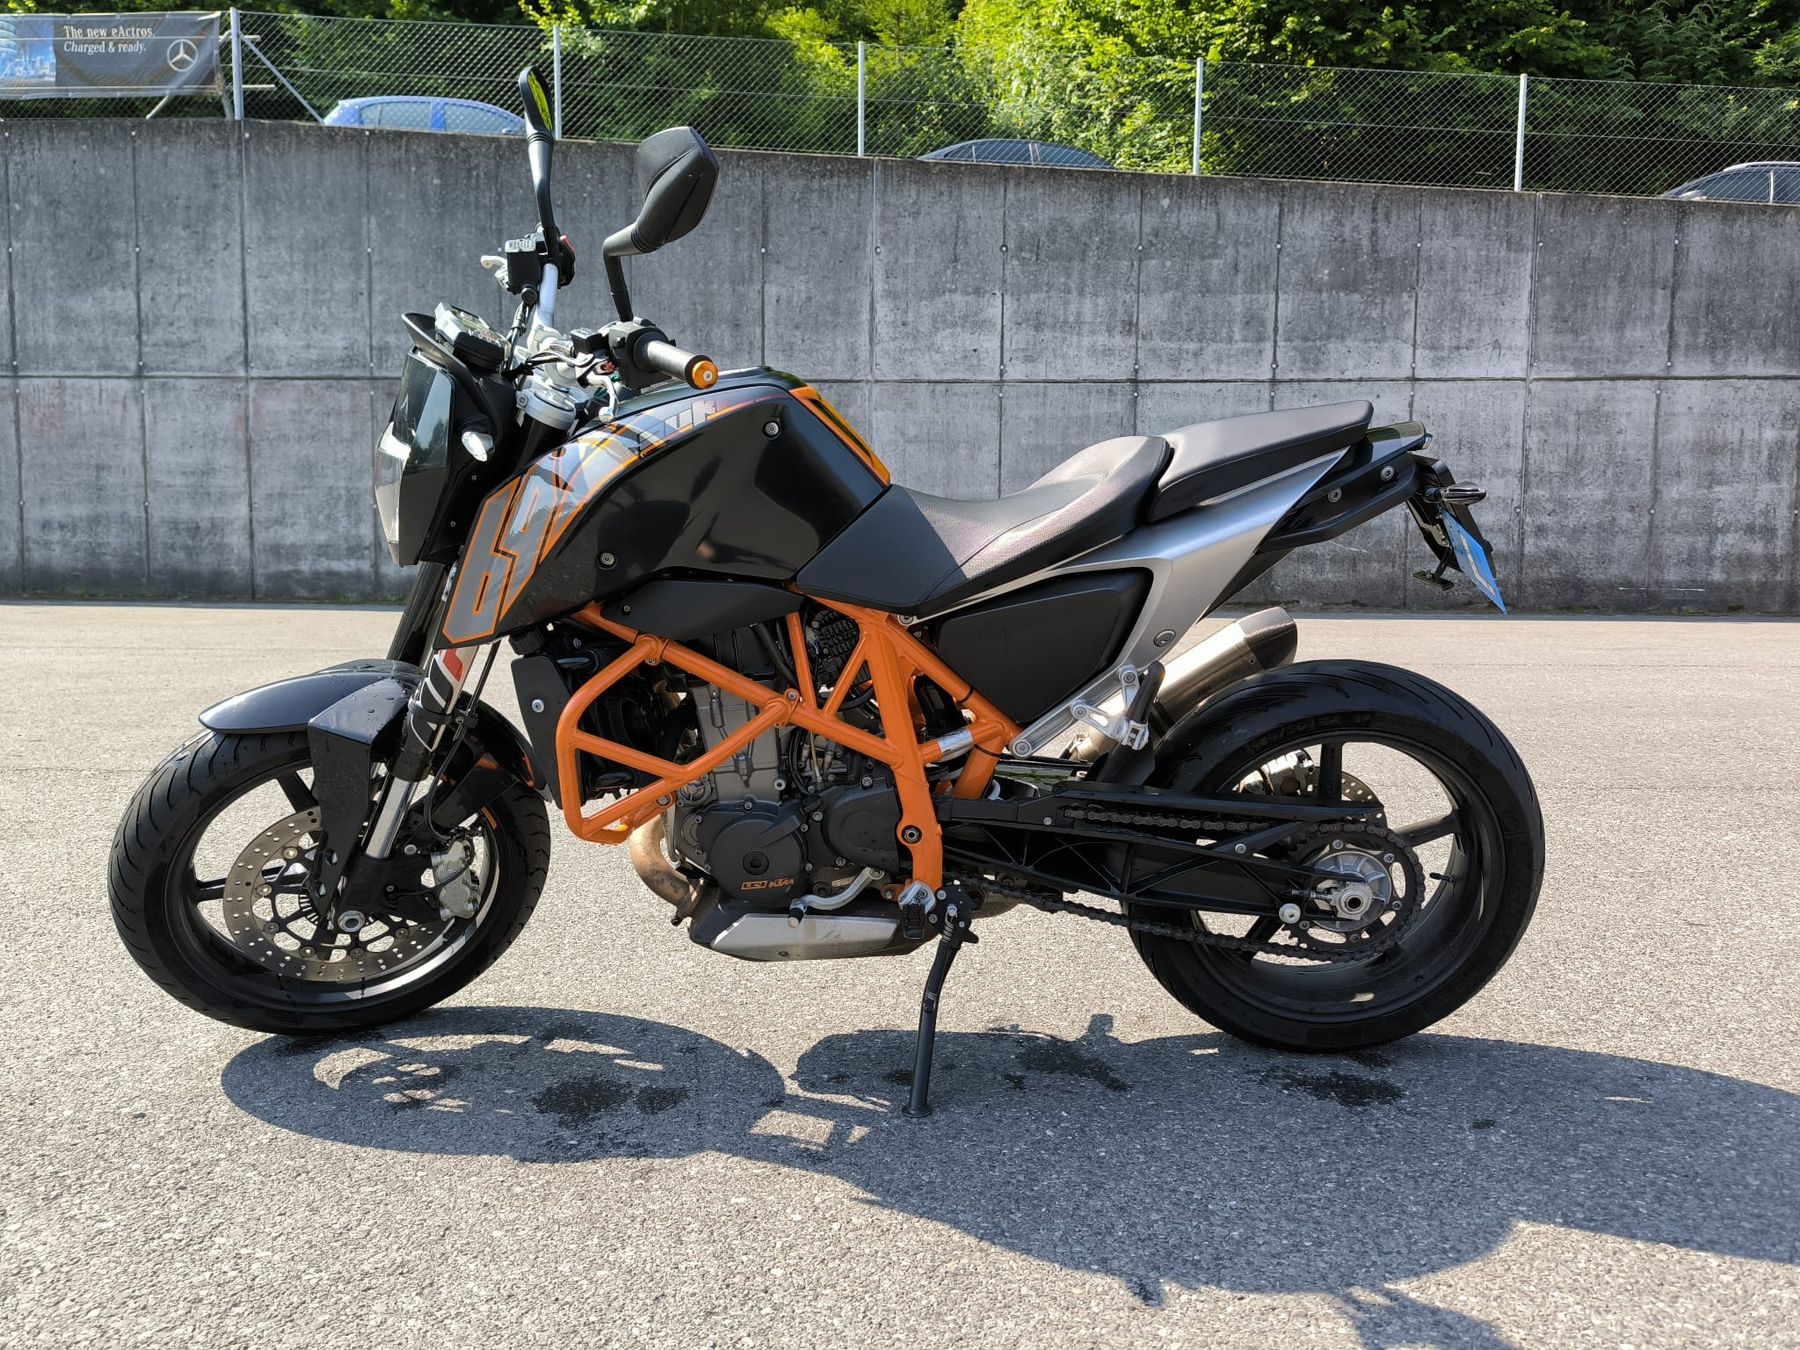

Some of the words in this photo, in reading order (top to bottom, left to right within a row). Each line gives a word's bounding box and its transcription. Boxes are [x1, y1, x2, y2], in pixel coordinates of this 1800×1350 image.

[64, 25, 83, 38] The
[87, 27, 107, 38] new
[111, 25, 156, 38] eActros.
[64, 41, 106, 55] Charged
[107, 41, 115, 53] &
[118, 41, 147, 54] ready.
